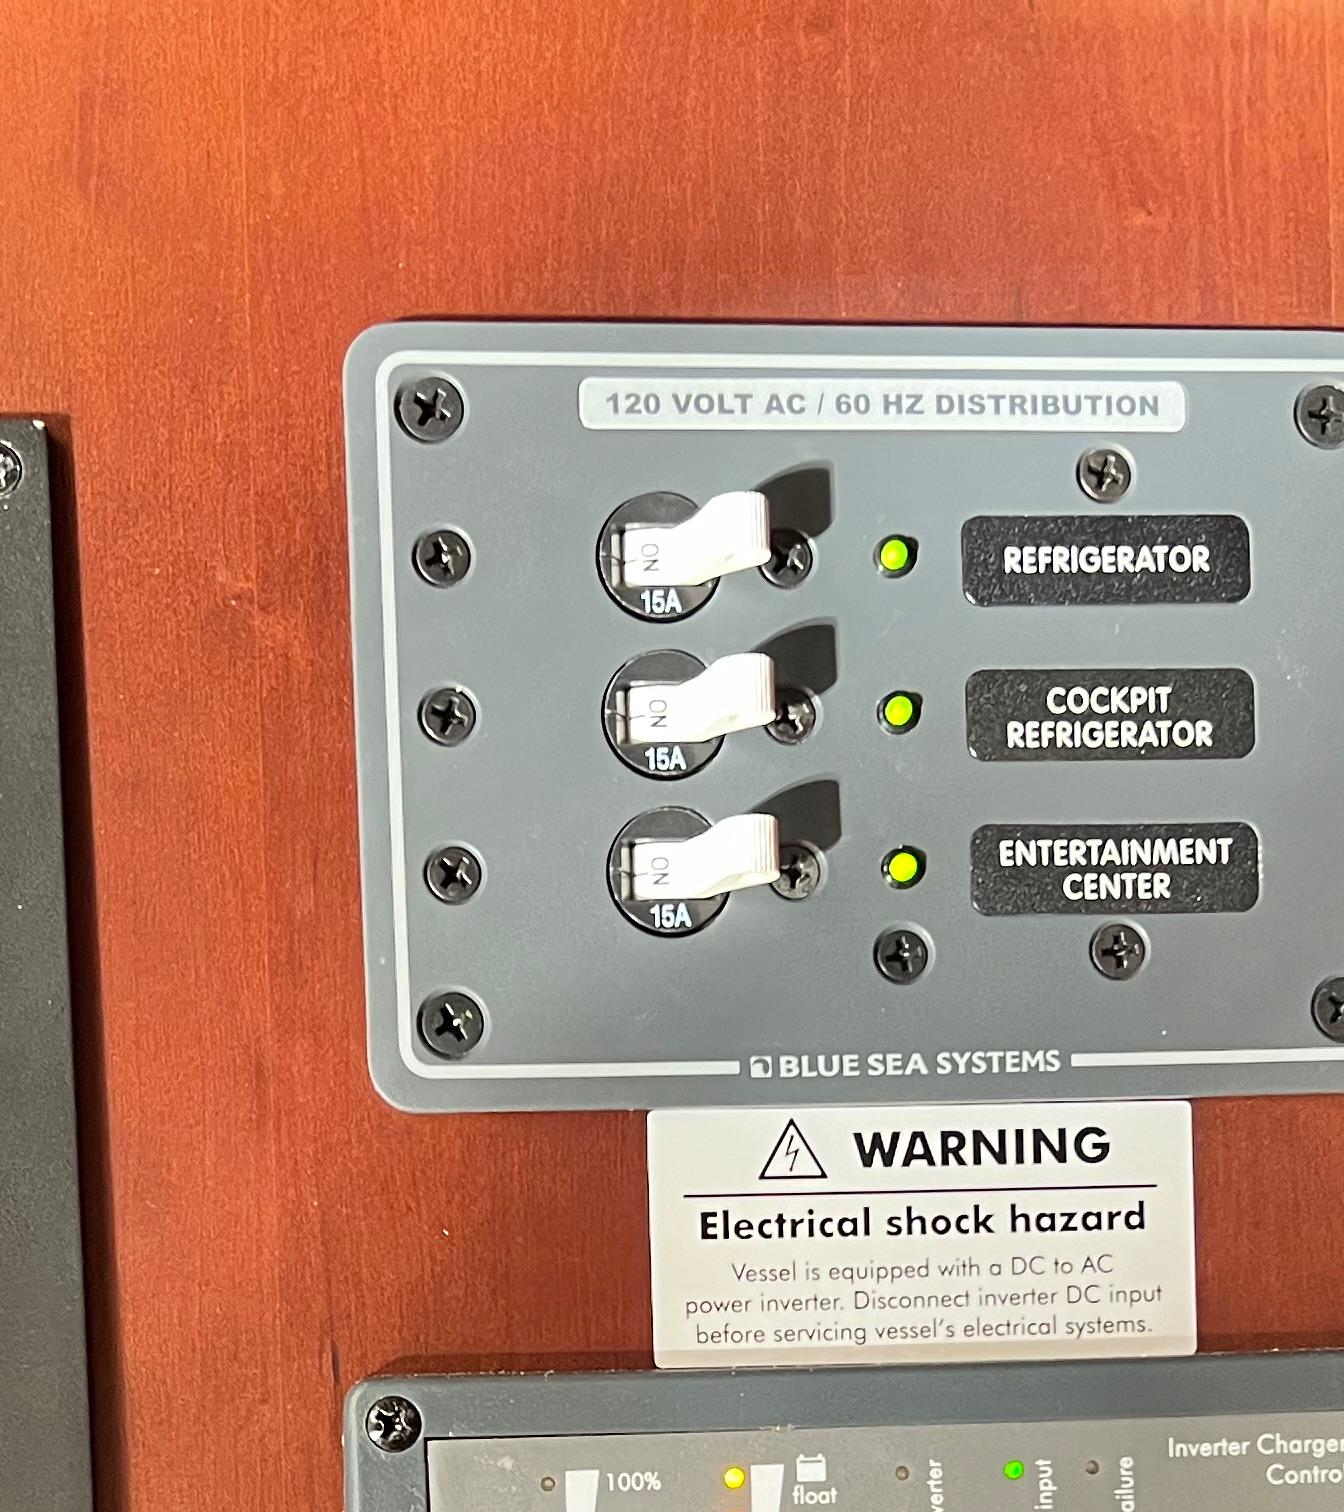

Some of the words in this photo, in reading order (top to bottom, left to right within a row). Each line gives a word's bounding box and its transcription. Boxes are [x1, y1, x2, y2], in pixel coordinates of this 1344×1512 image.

[606, 392, 660, 415] 120
[671, 393, 753, 415] VOLT
[765, 394, 806, 414] AC
[835, 393, 871, 415] 60
[882, 393, 924, 415] HZ
[936, 394, 1159, 417] DISTRIBUTION
[641, 543, 659, 572] ON
[1003, 545, 1210, 574] REFRIGERATOR
[640, 589, 682, 613] 15A
[649, 699, 667, 728] ON
[1046, 686, 1172, 714] COCKPIT
[1006, 720, 1213, 749] REFRIGERATOR
[644, 746, 686, 771] 15A
[998, 837, 1234, 867] ENTERTAINMENT
[651, 856, 669, 885] ON
[1062, 872, 1171, 900] CENTER
[650, 903, 692, 928] 15A
[779, 1055, 860, 1077] BLUE
[867, 1053, 928, 1076] SEA
[936, 1050, 1060, 1075] SYSTEMS
[853, 1127, 1110, 1168] WARNING
[700, 1207, 870, 1240] Electrical
[886, 1204, 994, 1237] shock
[1009, 1200, 1146, 1233] hazard
[732, 1261, 797, 1283] Vessel
[805, 1262, 822, 1281] is
[828, 1259, 930, 1285] equipped
[938, 1257, 981, 1278] with
[989, 1262, 1001, 1276] a
[1011, 1256, 1046, 1276] DC
[1053, 1257, 1073, 1274] to
[1081, 1254, 1114, 1274] AC
[686, 1297, 752, 1320] power
[760, 1291, 844, 1314] inverter.
[854, 1289, 971, 1311] Disconnect
[978, 1287, 1058, 1308] inverter
[1066, 1285, 1101, 1305] DC
[1108, 1284, 1163, 1309] input
[696, 1321, 765, 1345] before
[773, 1321, 867, 1346] servicing
[963, 1316, 1057, 1338] electrical
[1064, 1317, 1153, 1339] systems.
[1168, 1437, 1250, 1458] Inverter
[606, 1472, 662, 1492] 100%
[792, 1486, 837, 1505] float
[1034, 1459, 1058, 1510] input
